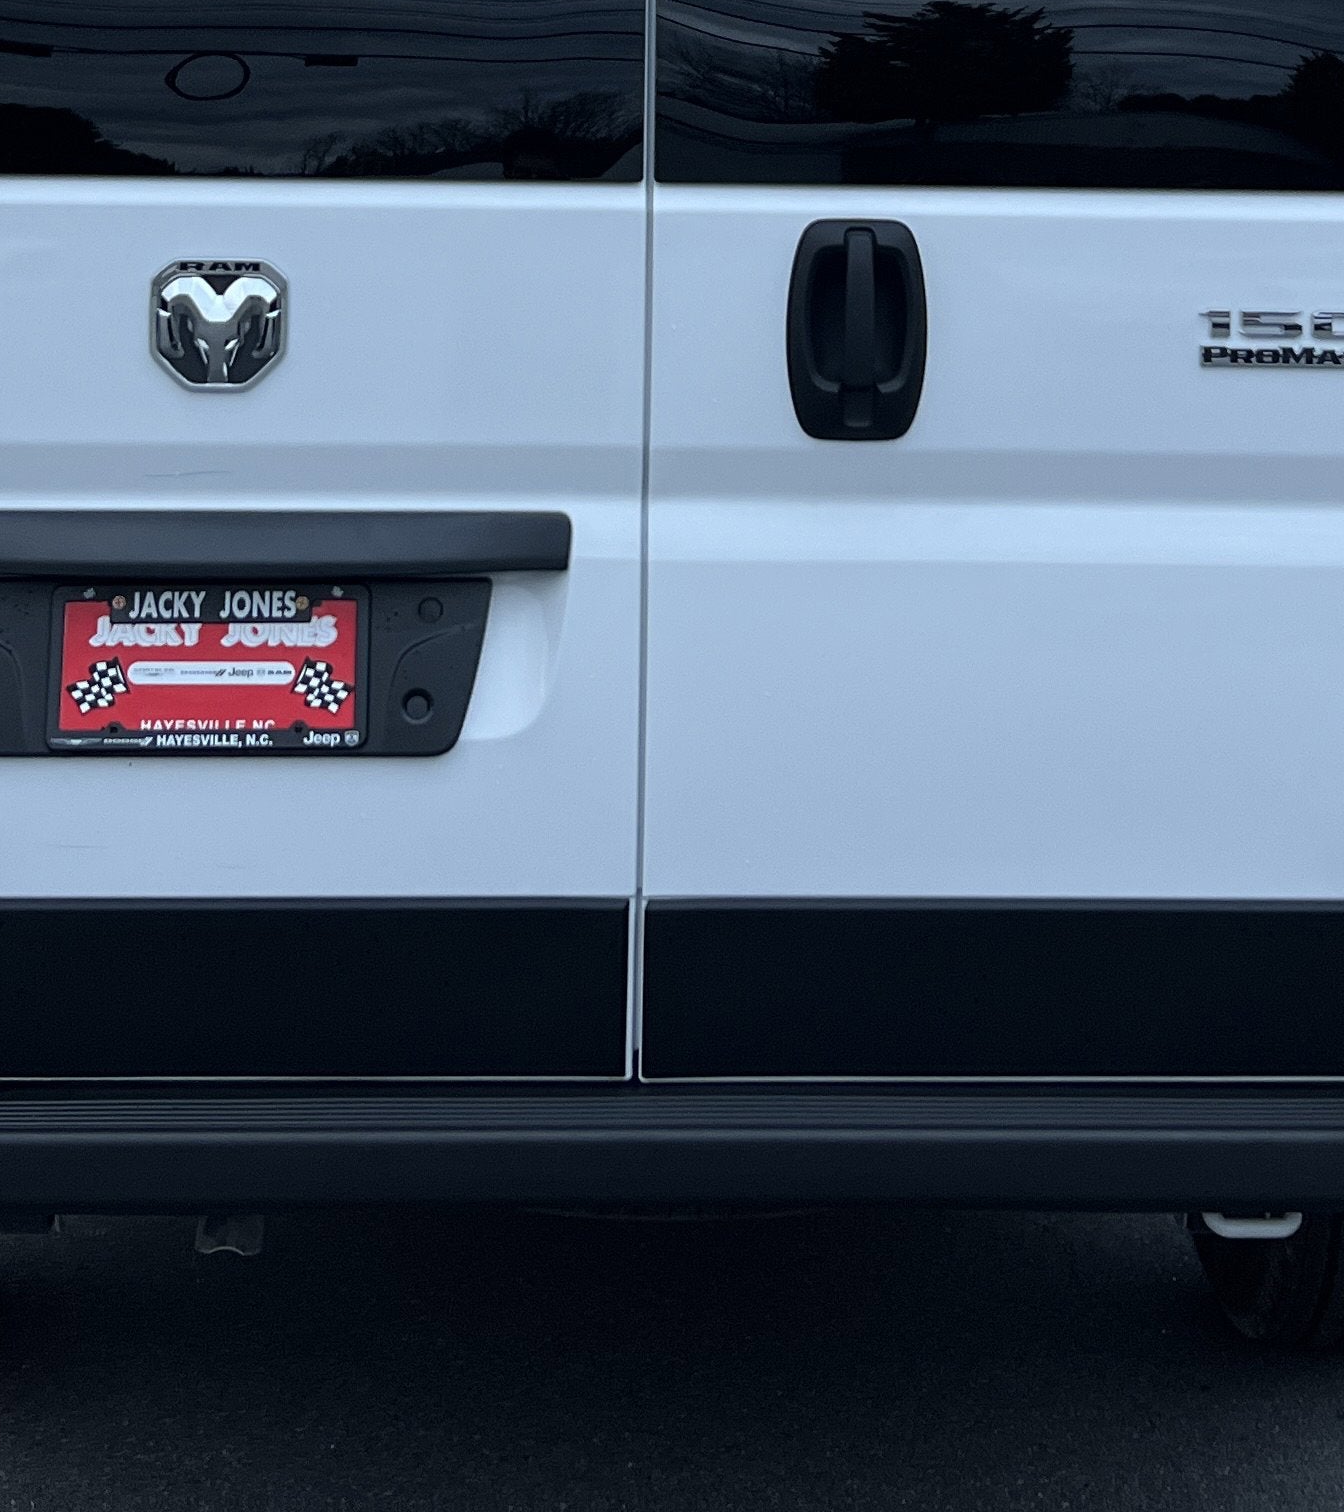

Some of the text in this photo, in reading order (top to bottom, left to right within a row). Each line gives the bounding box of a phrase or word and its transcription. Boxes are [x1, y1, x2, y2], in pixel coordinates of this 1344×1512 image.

[179, 261, 261, 272] RAM
[129, 590, 297, 619] JACKY JONES
[89, 616, 338, 647] JACKY JONES
[227, 666, 254, 678] Jeep
[156, 734, 242, 748] HAYESVILLE,
[246, 734, 273, 746] N.C.
[303, 731, 340, 747] Jeep
